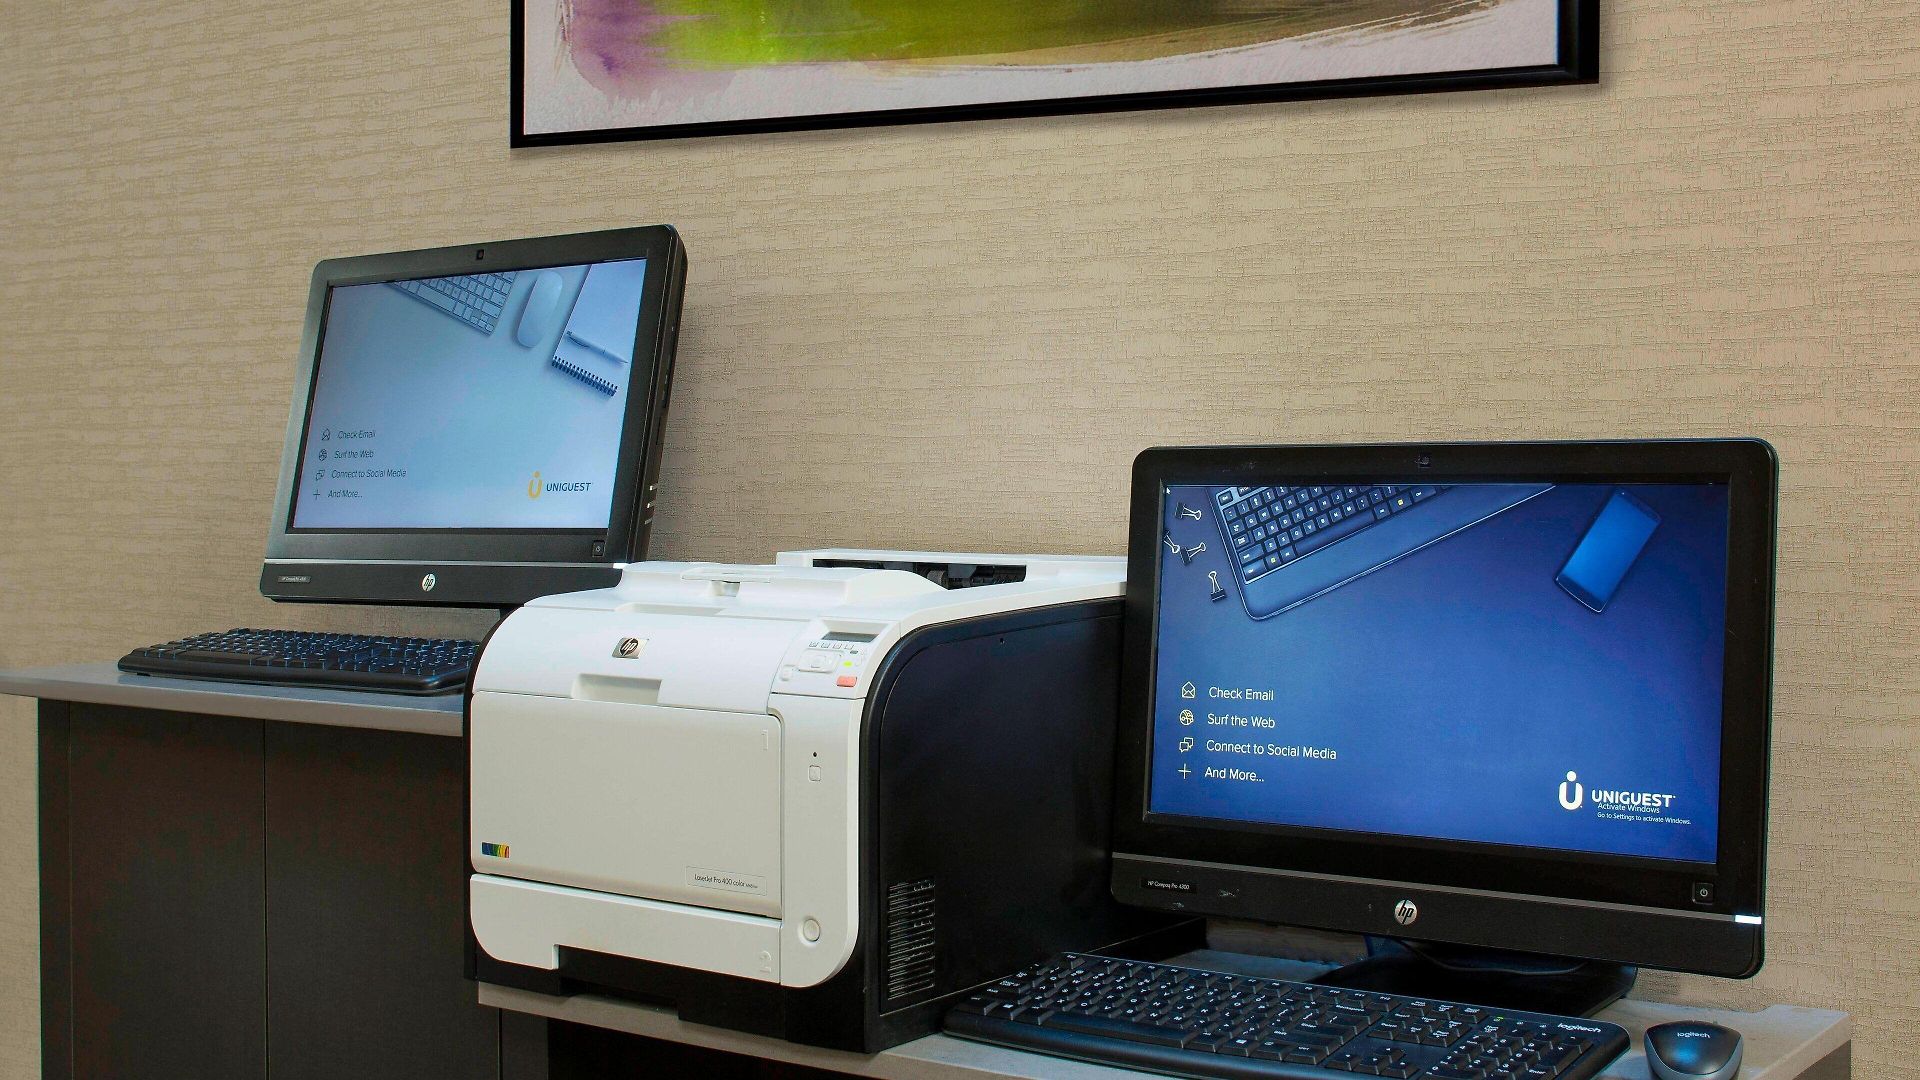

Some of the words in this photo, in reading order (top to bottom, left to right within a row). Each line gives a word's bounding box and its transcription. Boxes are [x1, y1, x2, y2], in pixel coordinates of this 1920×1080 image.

[337, 430, 358, 440] Check
[358, 429, 376, 439] Email
[334, 450, 348, 459] Surf
[348, 450, 358, 458] the
[360, 450, 374, 458] Web
[331, 469, 358, 479] Connect
[358, 470, 365, 478] to
[366, 468, 385, 478] Social
[386, 468, 407, 478] Media
[546, 482, 592, 492] UNIGUEST
[328, 489, 342, 498] And
[1208, 686, 1242, 700] Check
[1246, 688, 1274, 700] Email
[1207, 713, 1229, 725] Surf
[1231, 715, 1248, 726] the
[1250, 716, 1276, 728] Web
[1206, 740, 1251, 754] Connect
[1253, 744, 1265, 754] to
[1266, 744, 1300, 756] Social
[1302, 746, 1337, 760] Media
[1204, 766, 1226, 779] And
[1229, 768, 1264, 782] More...
[1592, 790, 1673, 808] UNIGUEST
[1598, 802, 1626, 810] Activate
[1628, 804, 1660, 814] Windows
[1613, 813, 1634, 821] Settings
[1396, 900, 1416, 924] hp
[1557, 1022, 1601, 1033] logitech
